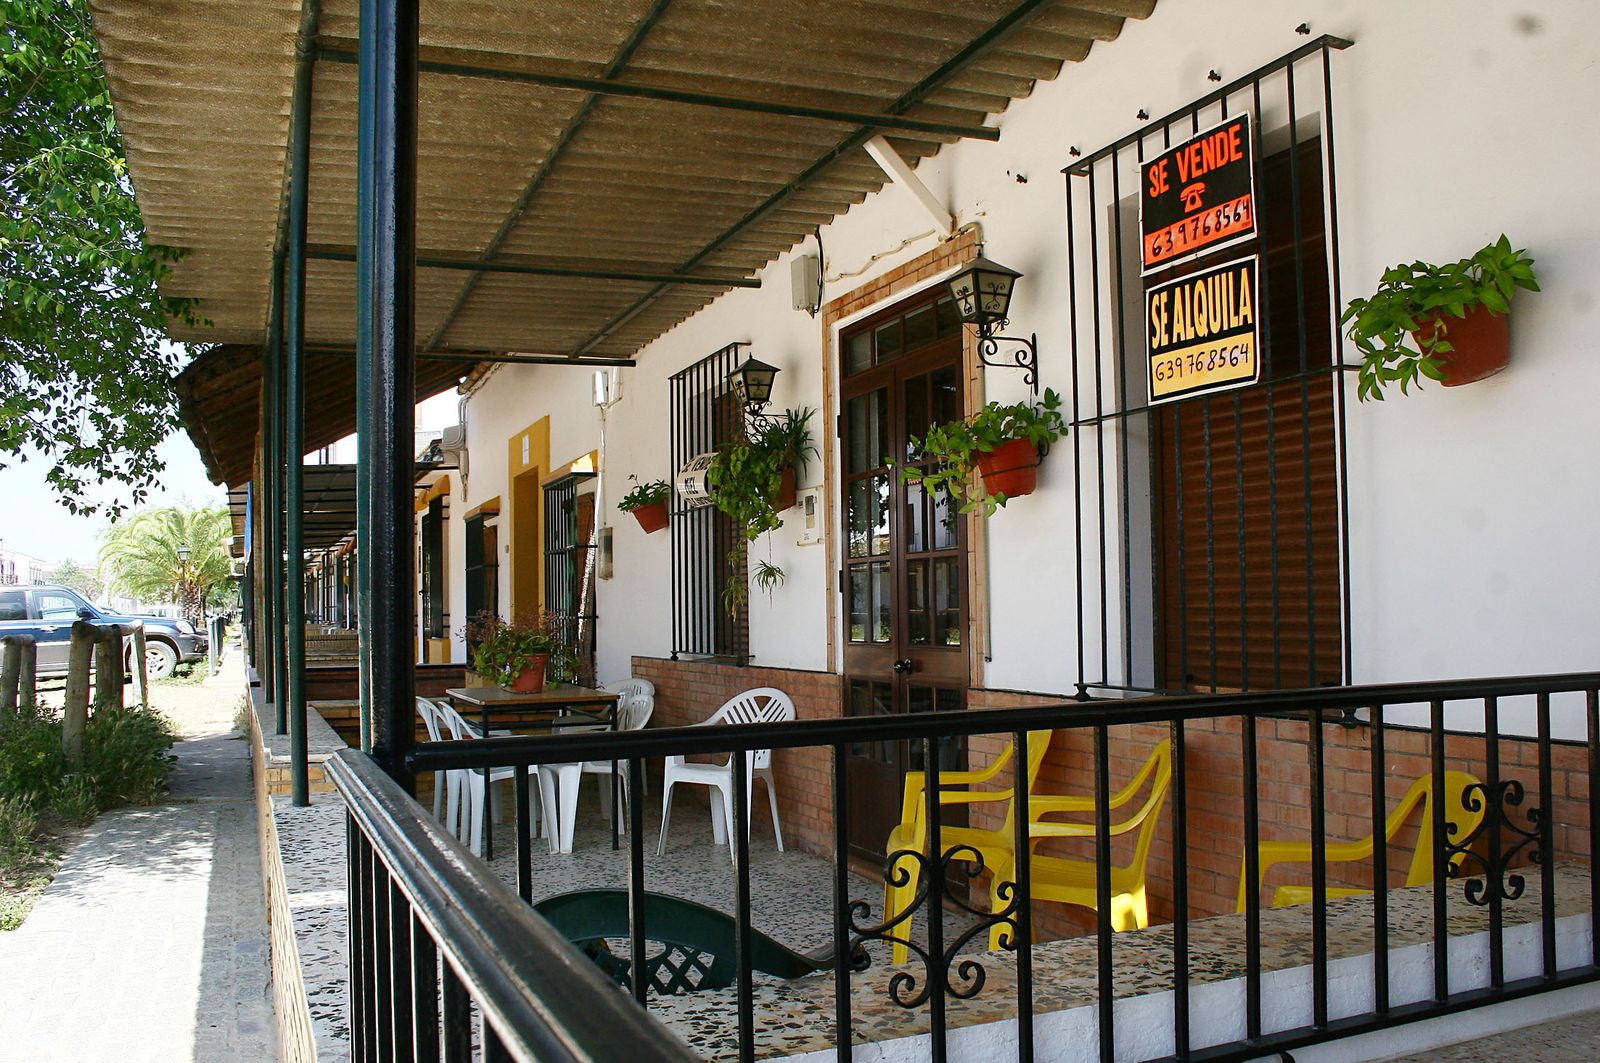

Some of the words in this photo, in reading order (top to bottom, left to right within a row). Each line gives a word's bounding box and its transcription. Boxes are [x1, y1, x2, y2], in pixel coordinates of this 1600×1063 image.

[1148, 158, 1170, 198] SE
[1176, 123, 1244, 183] VENDE
[1152, 198, 1250, 257] 639768564
[1151, 290, 1169, 350] SE
[1172, 267, 1253, 345] ALQUILA
[1155, 342, 1249, 382] 639768564
